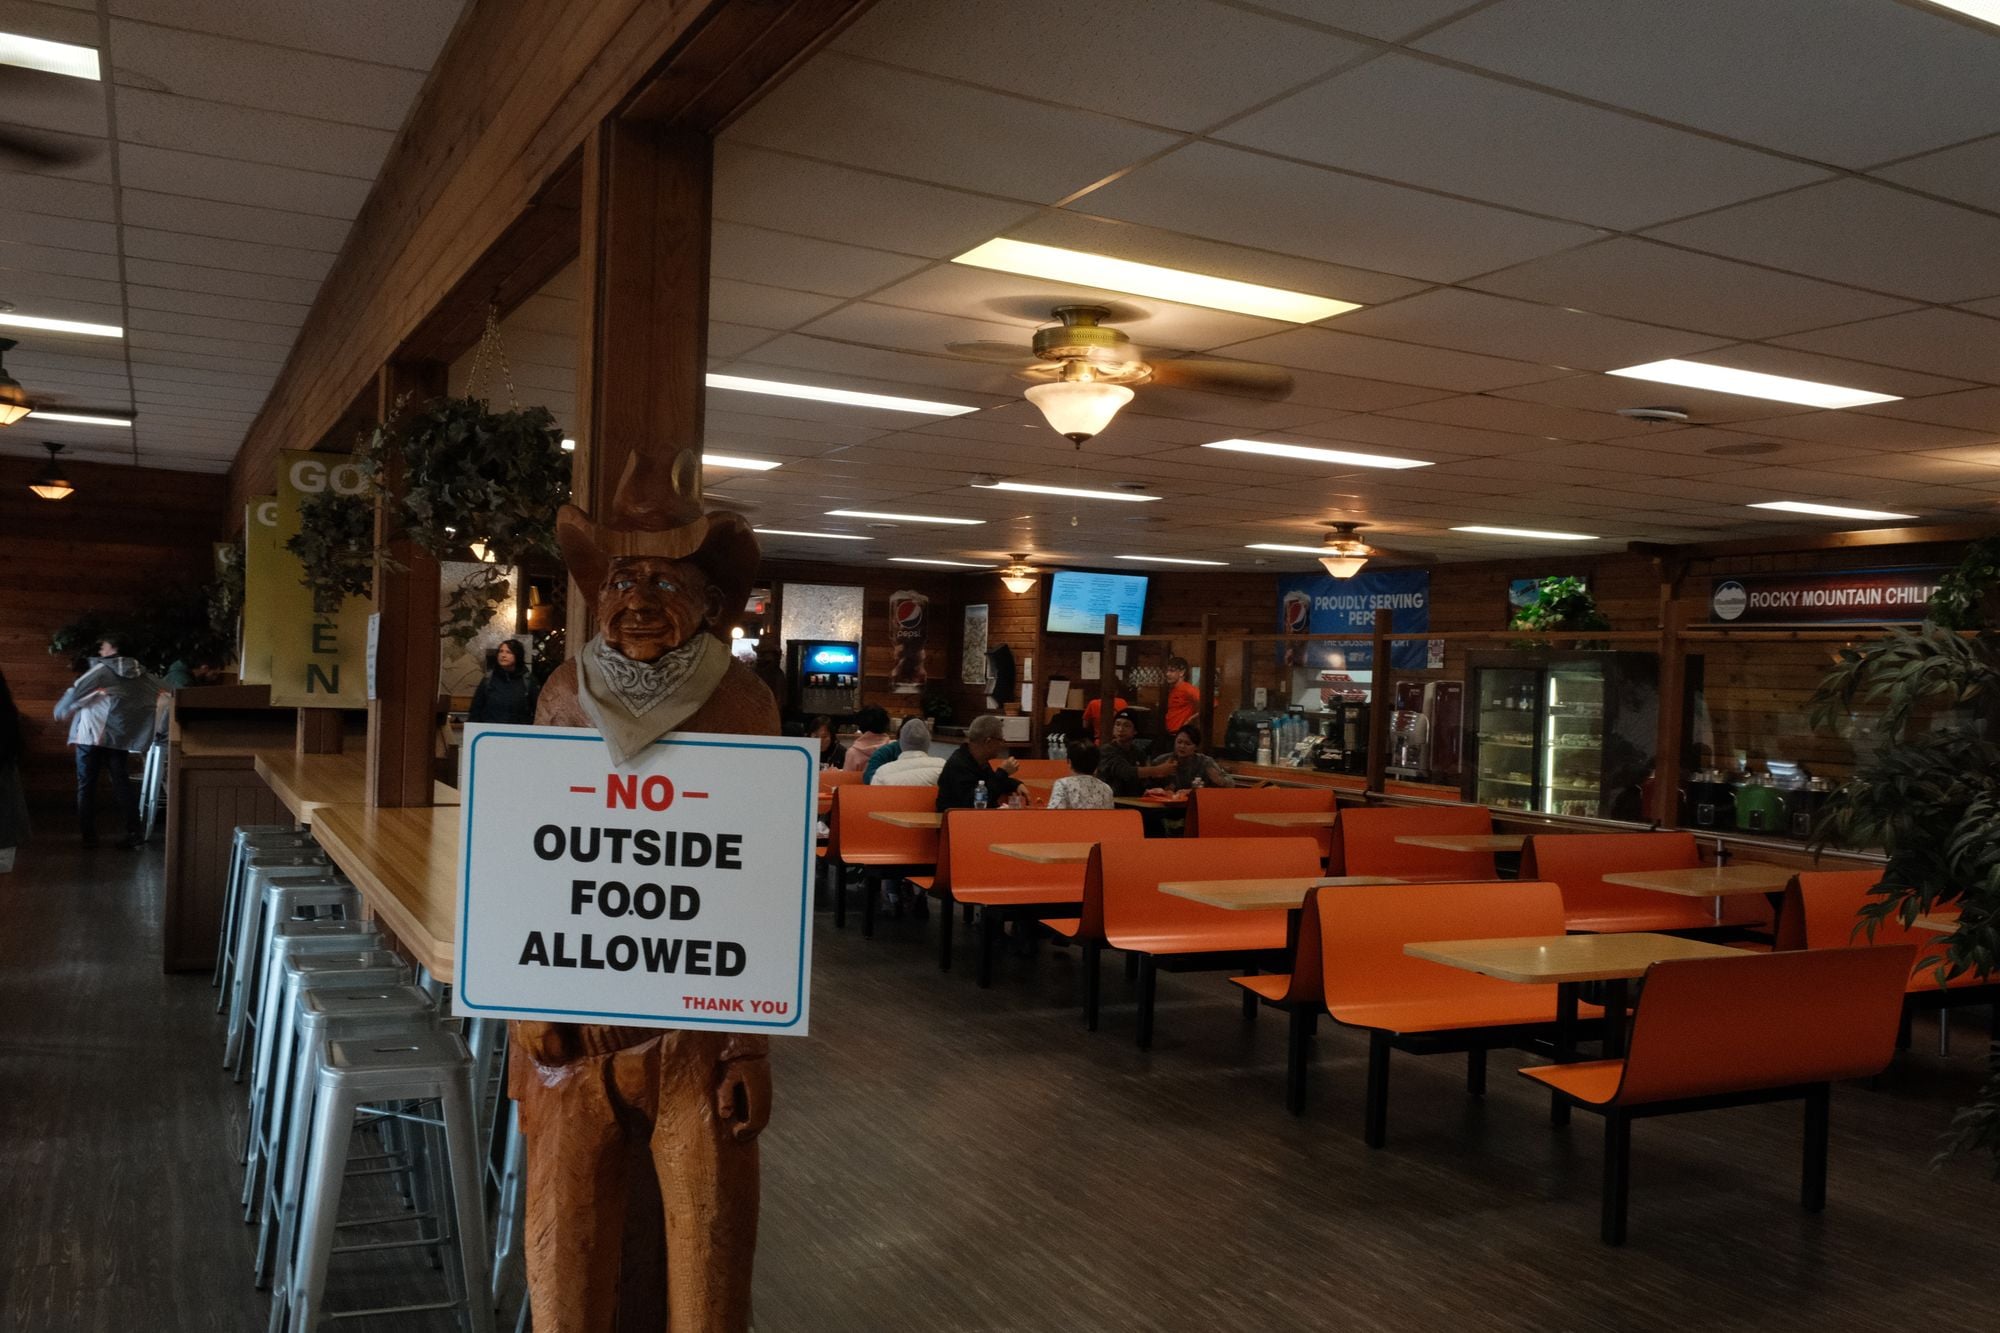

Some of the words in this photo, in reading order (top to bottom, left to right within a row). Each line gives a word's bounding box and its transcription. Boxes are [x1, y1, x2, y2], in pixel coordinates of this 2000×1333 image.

[256, 502, 277, 526] G
[1314, 595, 1367, 610] PROUDLY
[1369, 593, 1424, 609] SERVING
[1750, 592, 1799, 607] ROCKY
[1802, 588, 1882, 607] MOUNTAIN
[1885, 586, 1927, 604] CHILI
[1348, 611, 1376, 625] PEPS
[898, 629, 920, 639] pepsi
[606, 774, 674, 811] NO
[533, 824, 743, 870] OUTSIDE
[570, 880, 700, 920] FOOD
[518, 931, 746, 977] ALLOWED
[682, 996, 744, 1012] THANK
[750, 1000, 788, 1014] YOU
